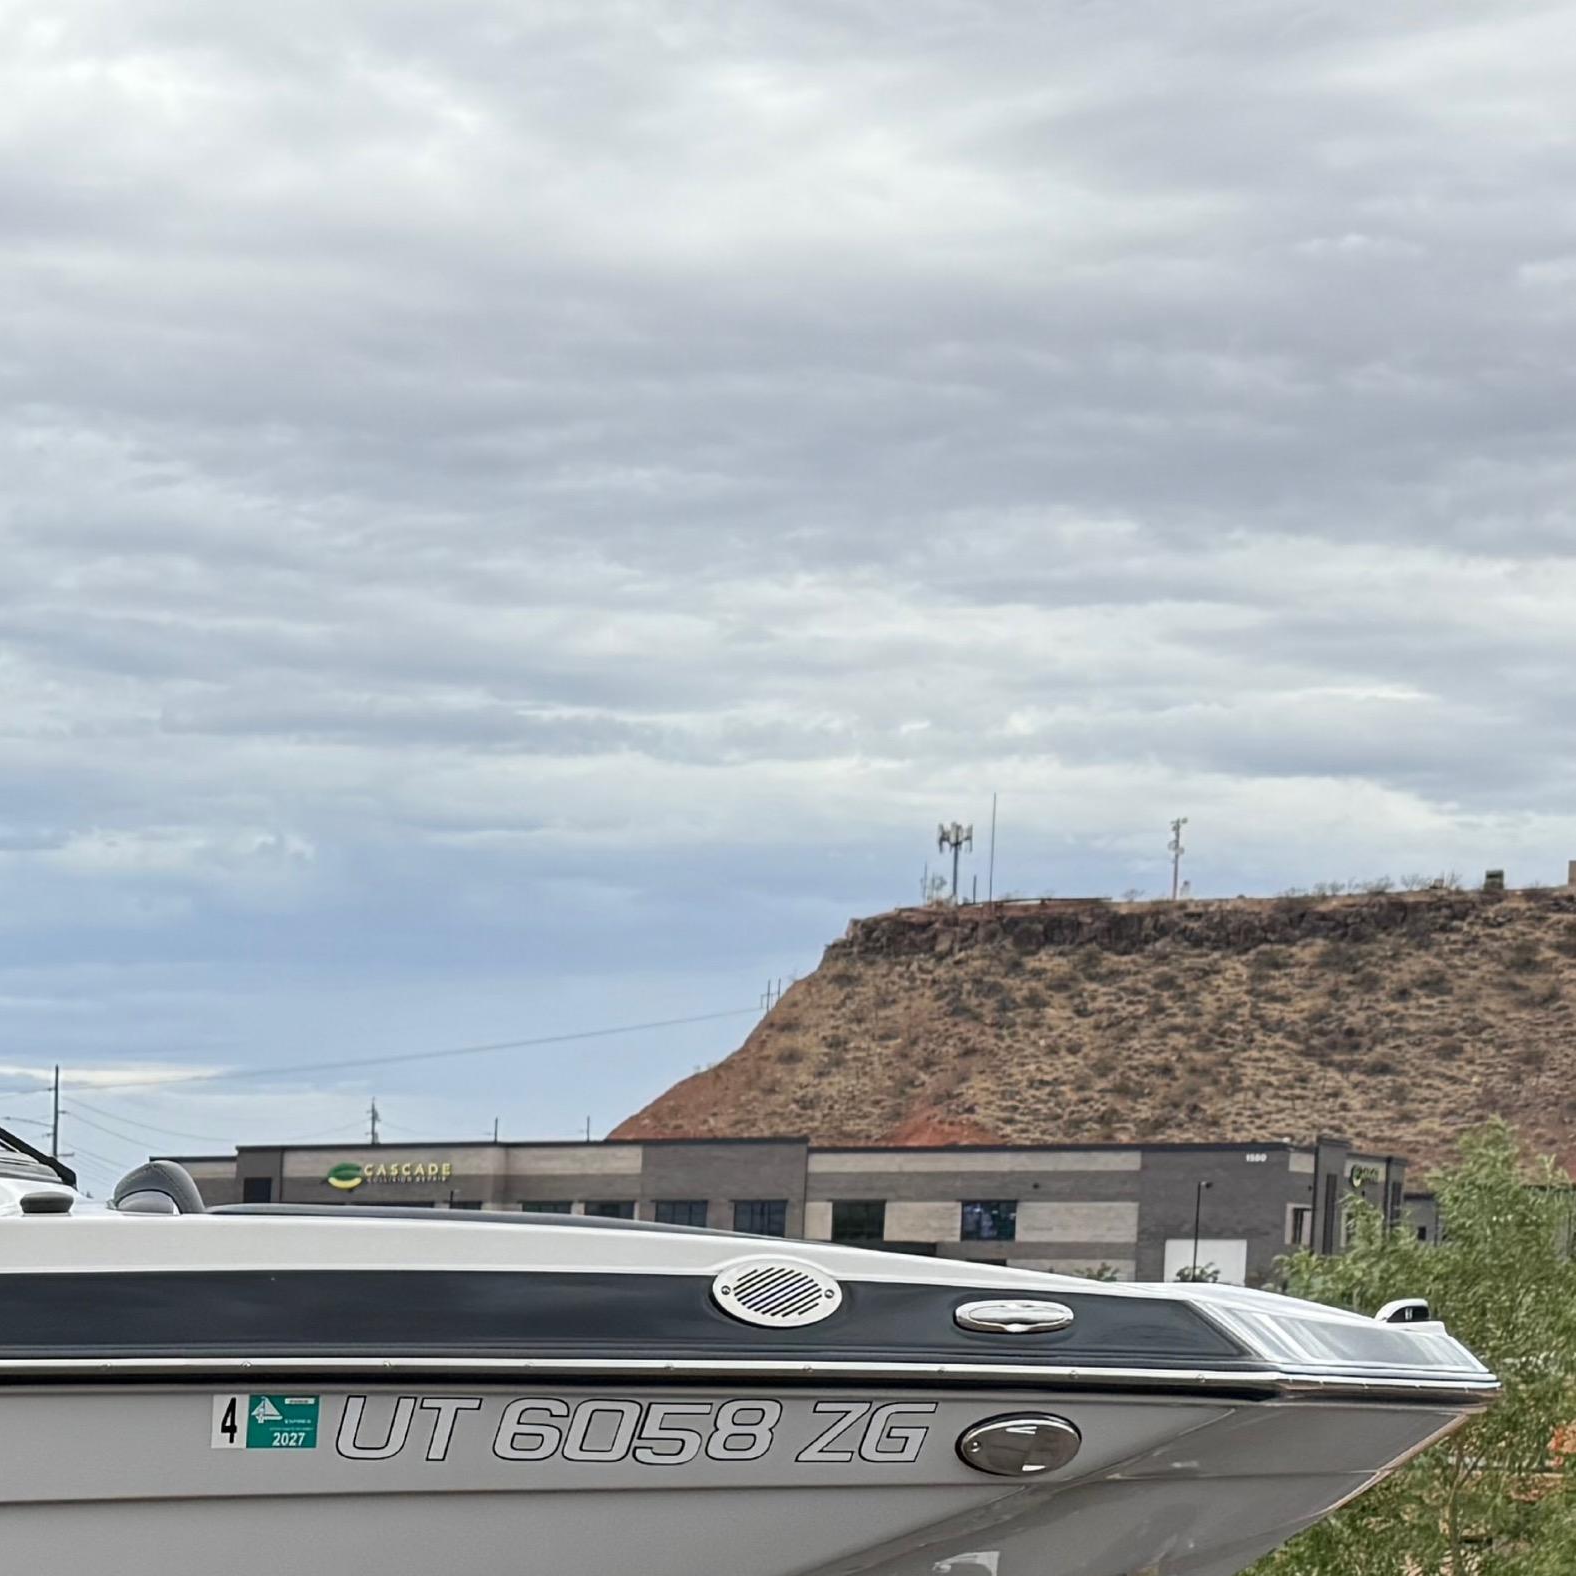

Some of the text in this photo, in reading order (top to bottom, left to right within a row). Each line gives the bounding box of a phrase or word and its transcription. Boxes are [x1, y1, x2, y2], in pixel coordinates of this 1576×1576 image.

[364, 1163, 451, 1175] CASCADE
[220, 1397, 238, 1444] 4
[335, 1395, 939, 1465] UT 6058 ZG
[272, 1432, 306, 1447] 2027
